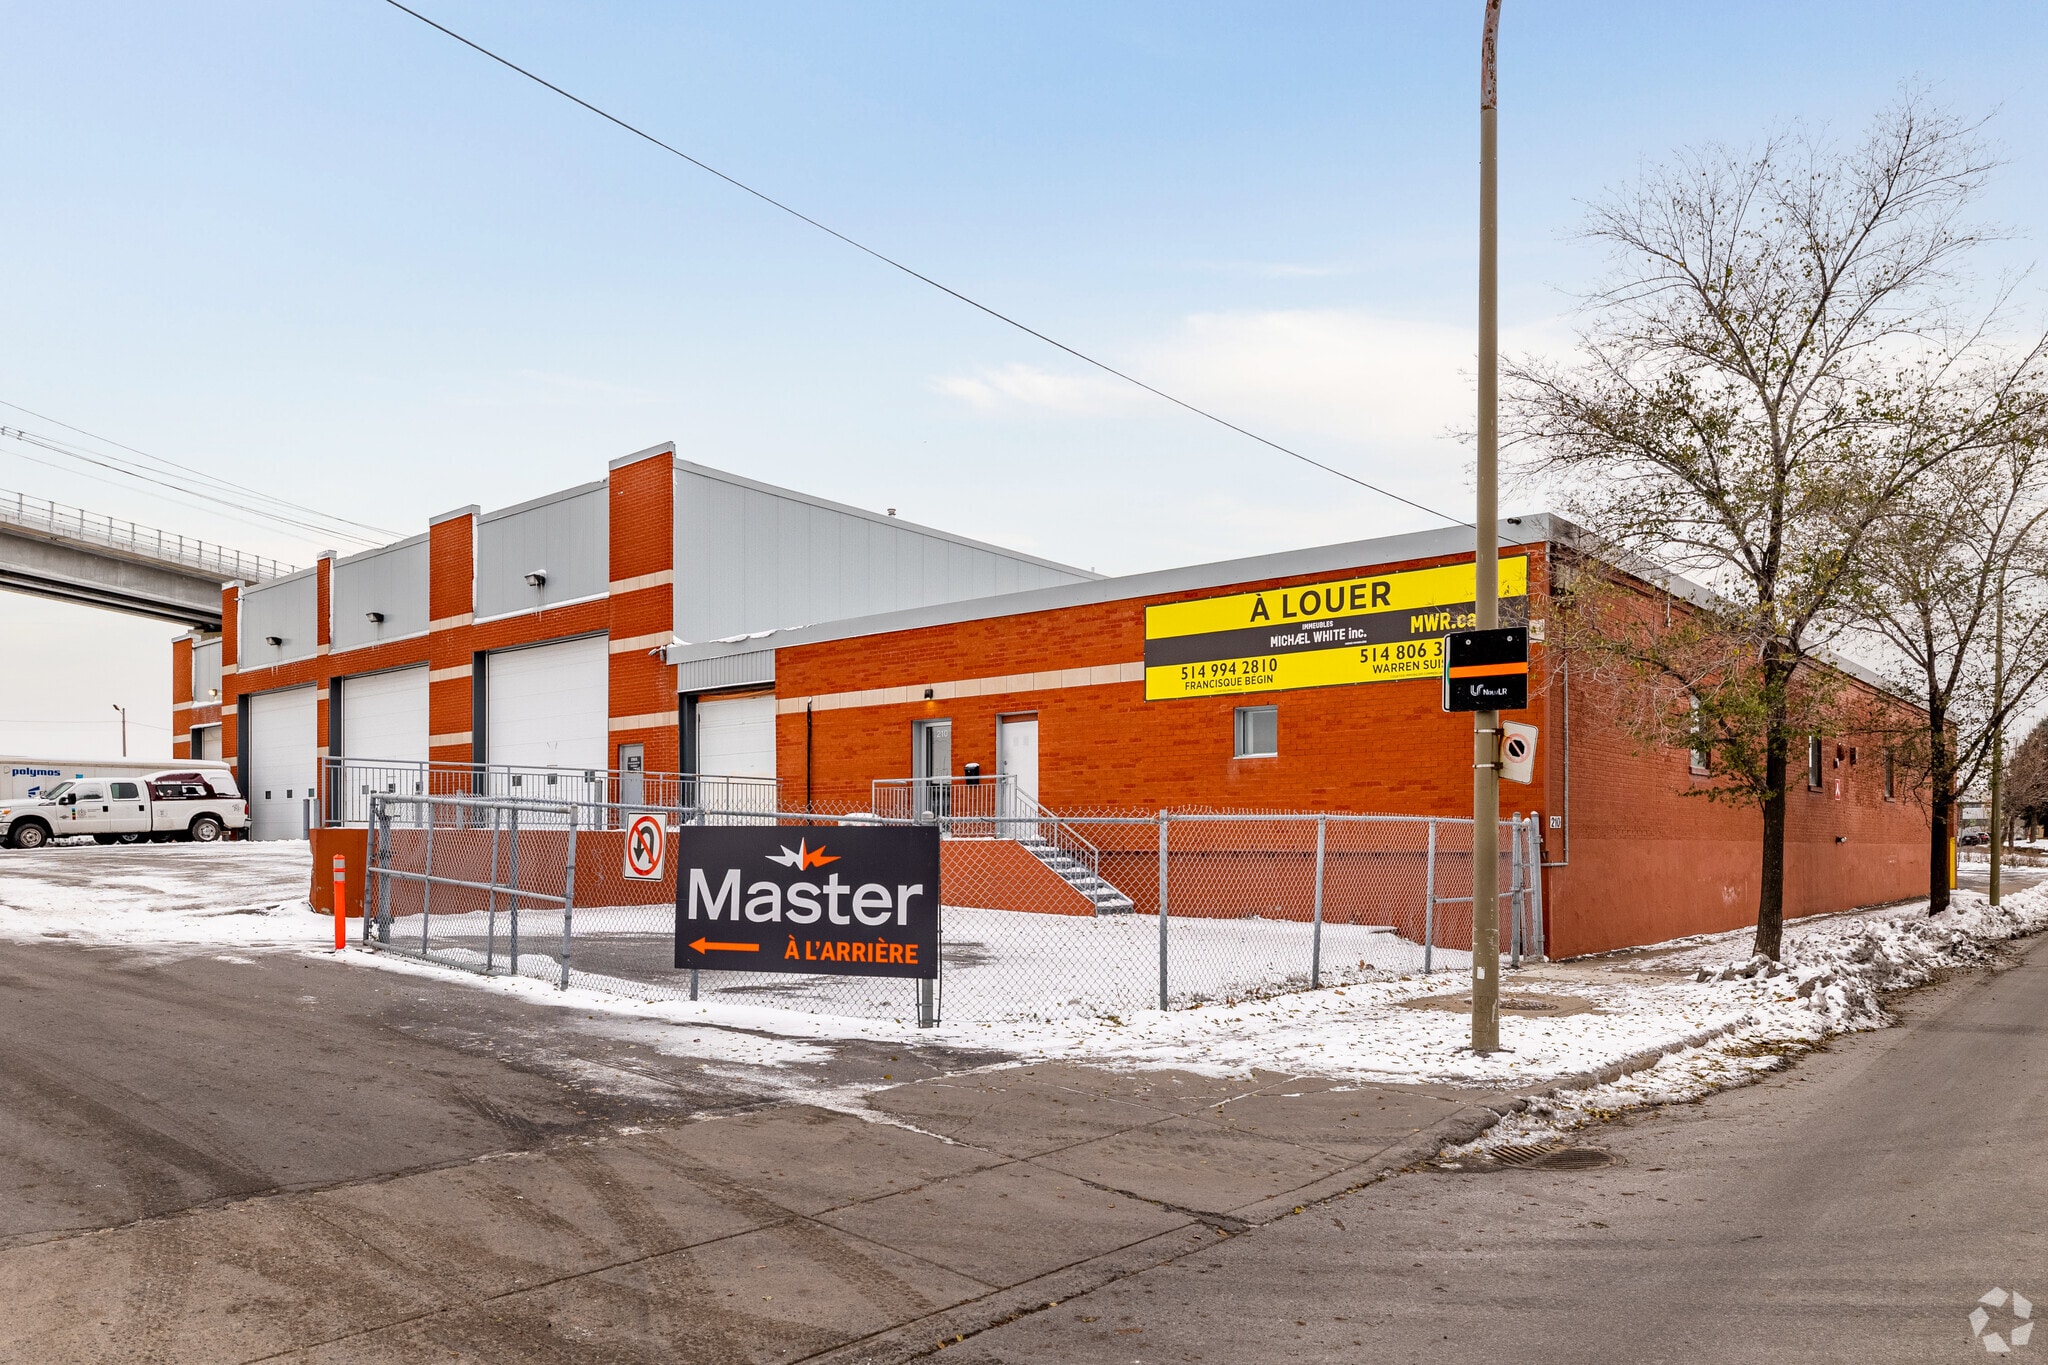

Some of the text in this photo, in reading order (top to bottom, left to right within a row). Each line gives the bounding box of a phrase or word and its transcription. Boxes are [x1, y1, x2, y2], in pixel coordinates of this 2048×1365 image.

[1250, 581, 1391, 622] À LOUER
[1302, 620, 1334, 630] IMMEUBLES
[1410, 612, 1476, 634] MWR.ca
[1313, 628, 1346, 643] WHITE
[1348, 627, 1367, 640] inc.
[1360, 646, 1389, 663] 514
[1396, 643, 1426, 660] 806
[1181, 658, 1277, 680] 514 994 2810
[1372, 659, 1444, 674] WARREN SUI
[1185, 677, 1242, 690] FRANCISQUE
[936, 730, 948, 738] 210
[12, 767, 61, 777] polymos
[1551, 817, 1561, 828] 210
[688, 868, 923, 926] Master
[784, 933, 919, 964] À L'ARRIÈRE
